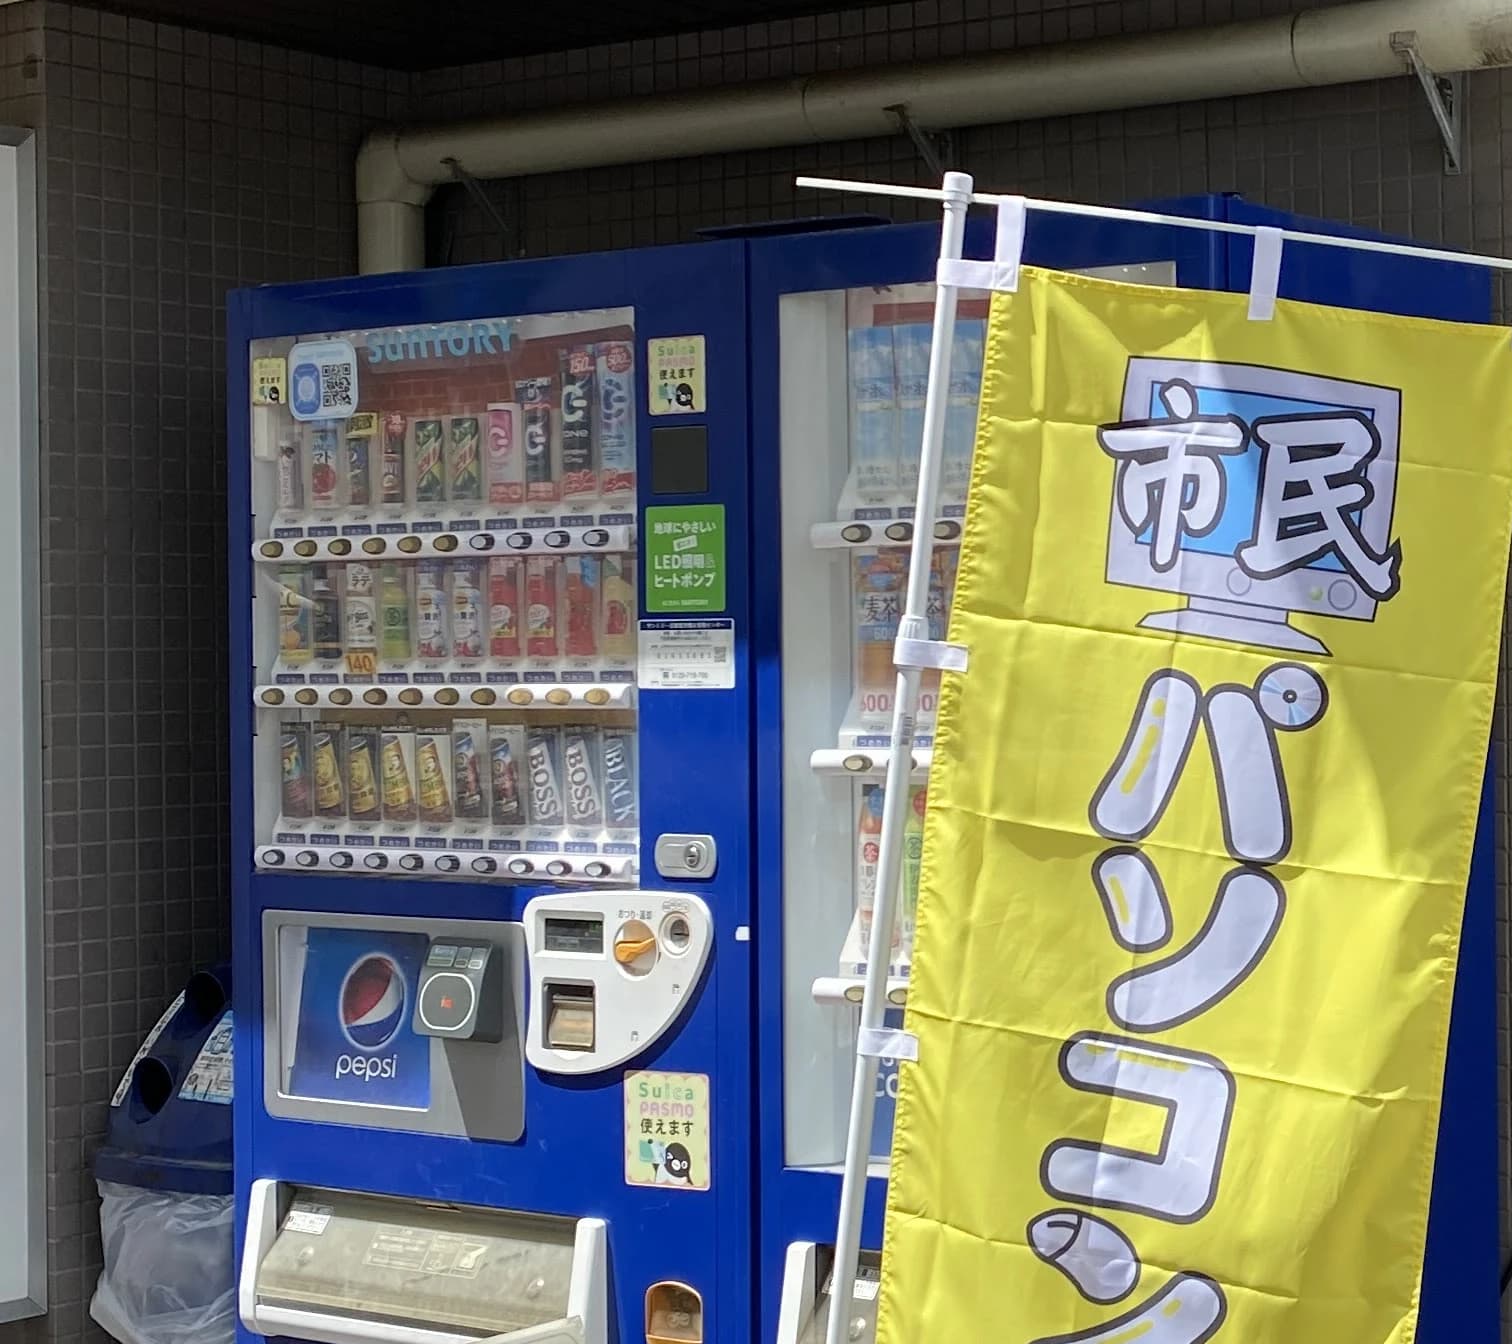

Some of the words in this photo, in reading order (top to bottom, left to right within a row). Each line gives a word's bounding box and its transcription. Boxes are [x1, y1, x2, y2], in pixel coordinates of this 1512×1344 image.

[1098, 377, 1402, 602] 市民
[654, 520, 717, 535] 地球にやさしい
[864, 594, 898, 623] 麦茶
[346, 655, 373, 673] 140
[530, 749, 557, 816] BOSS
[567, 749, 596, 816] BOSS
[335, 1052, 397, 1083] pepsi
[639, 1081, 694, 1100] Suica
[639, 1101, 695, 1118] PASMO
[640, 1118, 694, 1136] 使えます
